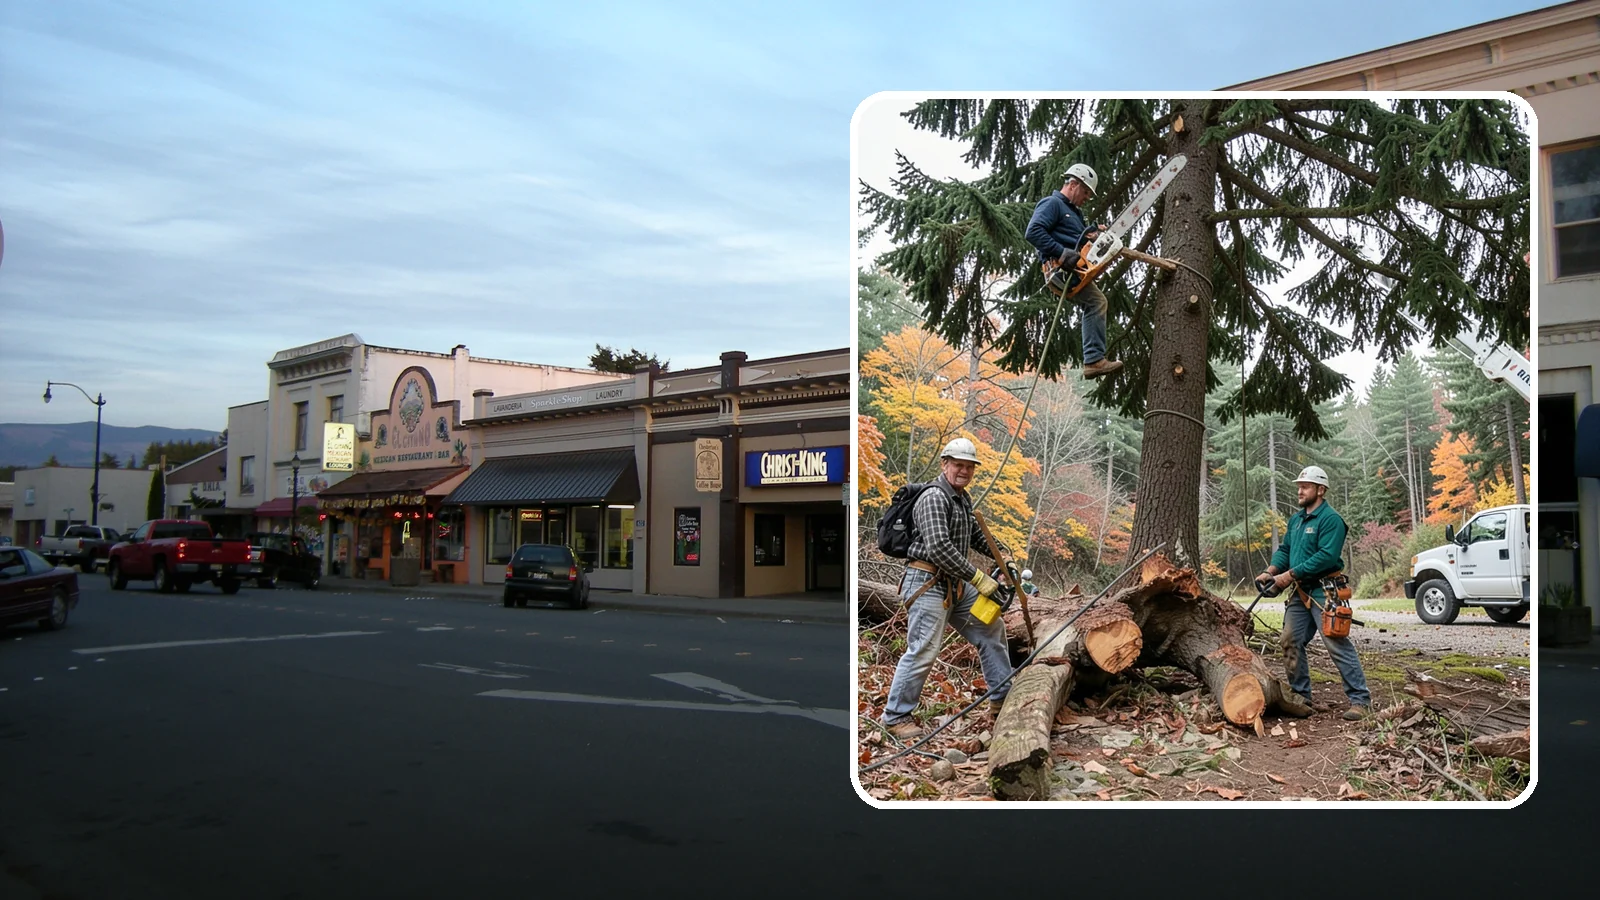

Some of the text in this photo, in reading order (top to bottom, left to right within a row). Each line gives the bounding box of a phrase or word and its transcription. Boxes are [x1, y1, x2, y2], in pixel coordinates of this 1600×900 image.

[595, 388, 624, 400] LAUNDRY
[493, 401, 523, 413] LAVANDERIA
[530, 394, 583, 409] Sparkle Shop
[373, 450, 450, 464] MEXICAN RESTAURANT BAR
[798, 450, 827, 476] KING
